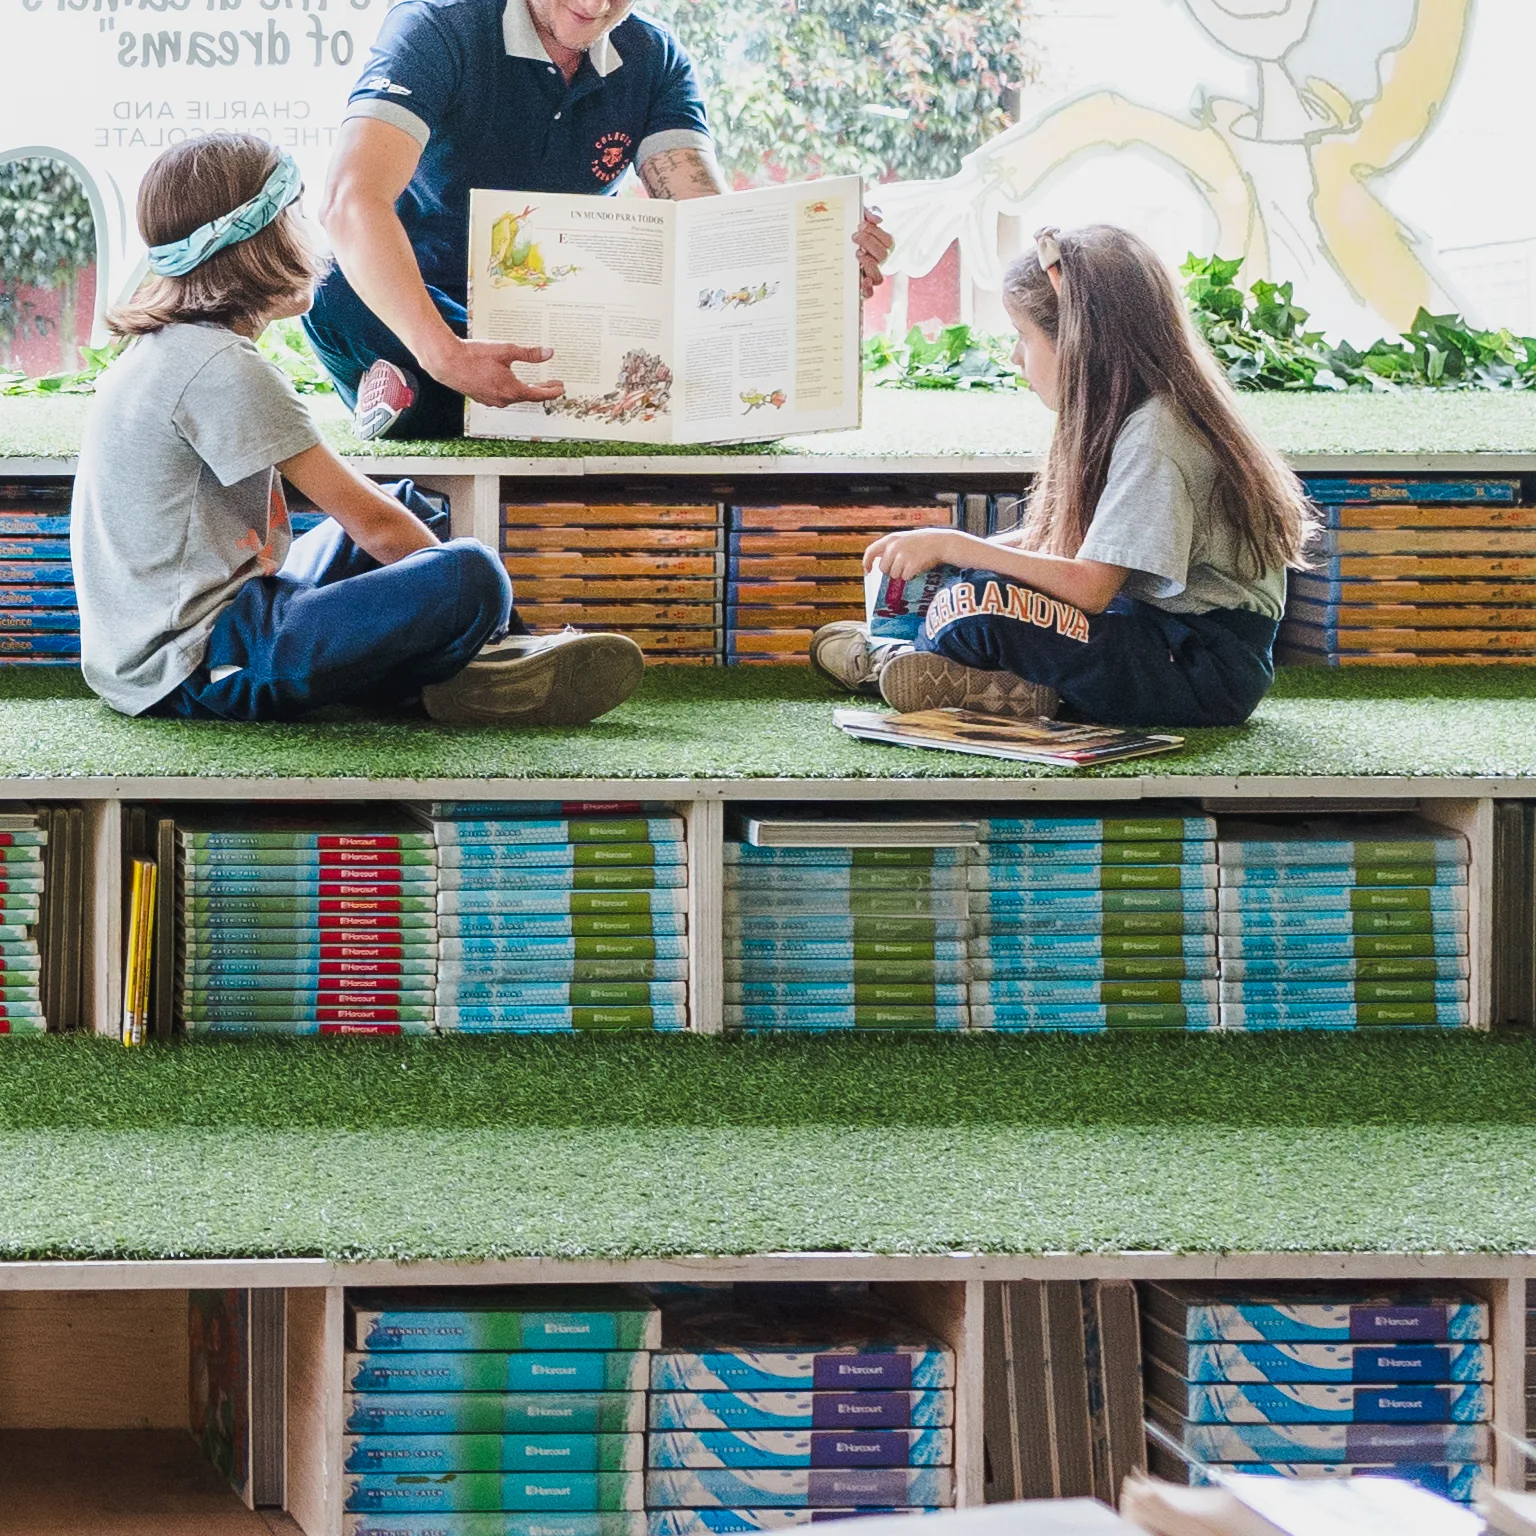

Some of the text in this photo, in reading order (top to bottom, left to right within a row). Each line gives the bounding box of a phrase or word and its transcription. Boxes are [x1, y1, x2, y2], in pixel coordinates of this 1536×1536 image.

[571, 210, 664, 224] UN MUNDO PARA TODOS
[1386, 1316, 1420, 1327] Harcourt
[386, 1324, 590, 1335] WINNING CATCH Harcourt
[1388, 1358, 1422, 1368] Harcourt
[541, 1366, 577, 1376] Harcourt
[848, 1365, 884, 1376] Harcourt
[848, 1404, 883, 1414] Harcourt
[1390, 1399, 1423, 1409] Harcourt
[846, 1443, 881, 1453] Harcourt
[368, 1450, 443, 1458] WINNING CATCH
